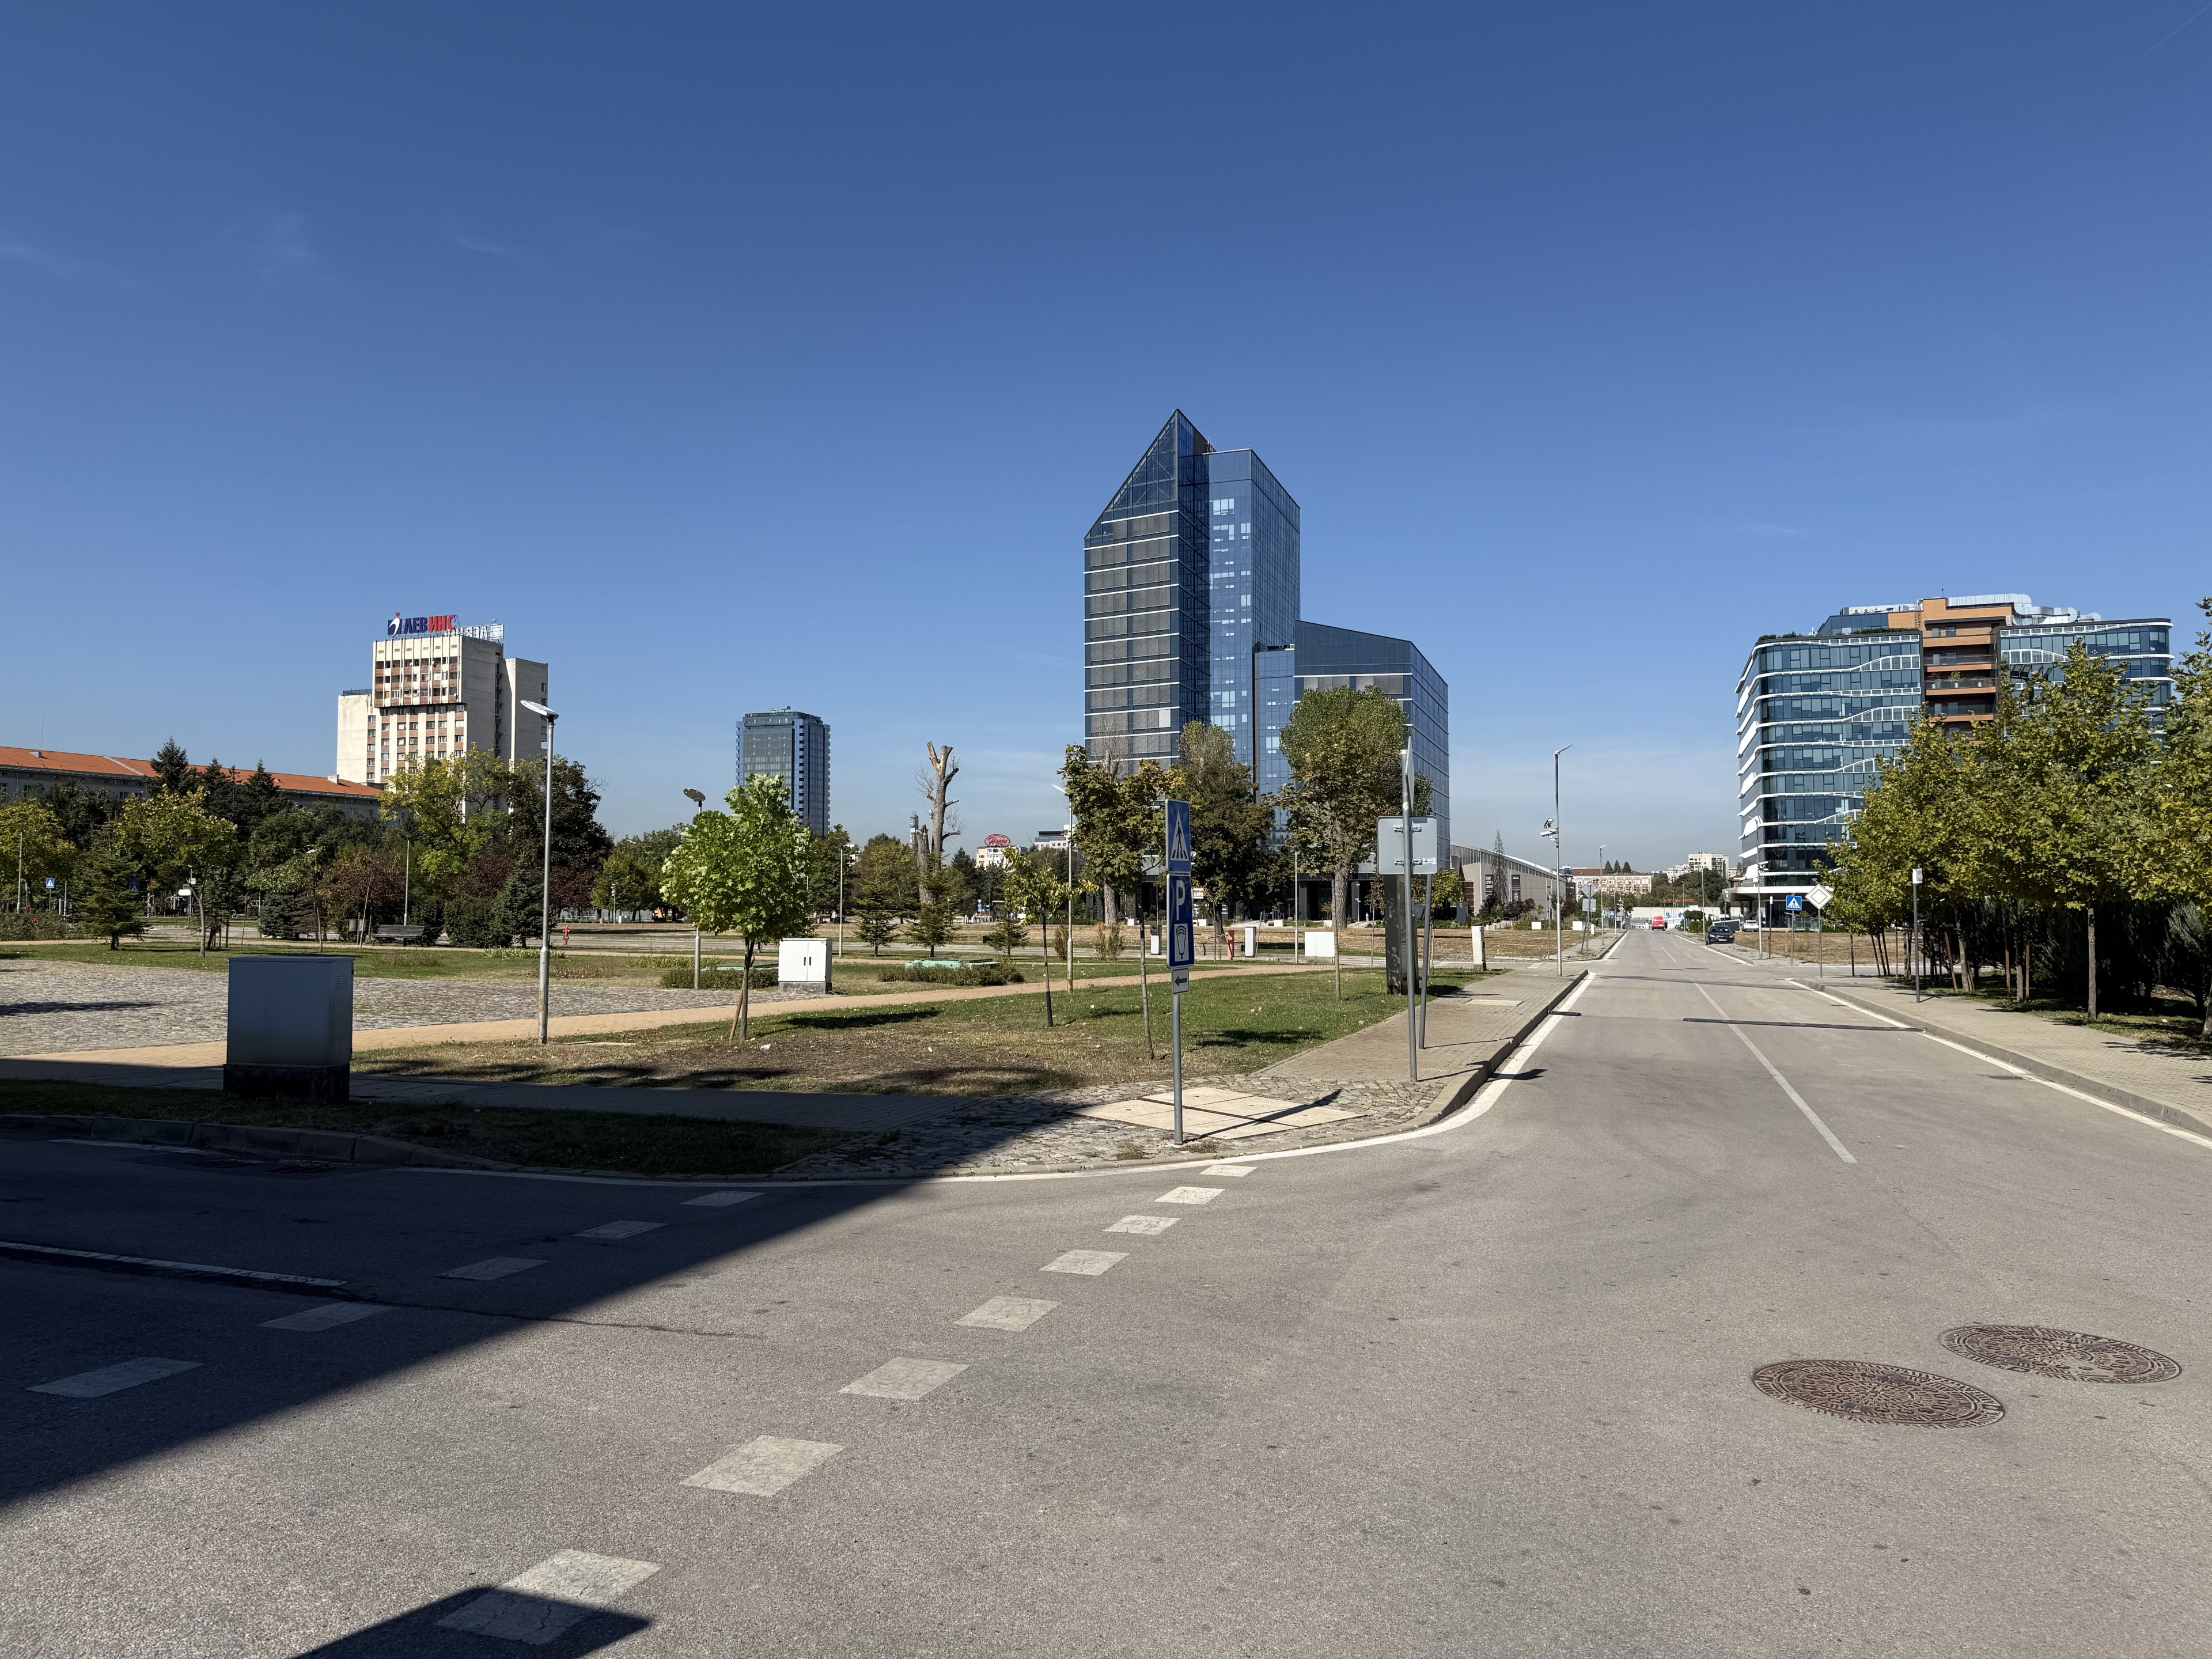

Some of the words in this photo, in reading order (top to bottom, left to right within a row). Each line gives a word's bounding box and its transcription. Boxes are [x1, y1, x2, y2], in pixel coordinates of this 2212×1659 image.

[404, 615, 456, 634] ЛЕВИНС
[987, 837, 1008, 845] Happy
[1176, 880, 1185, 921] P
